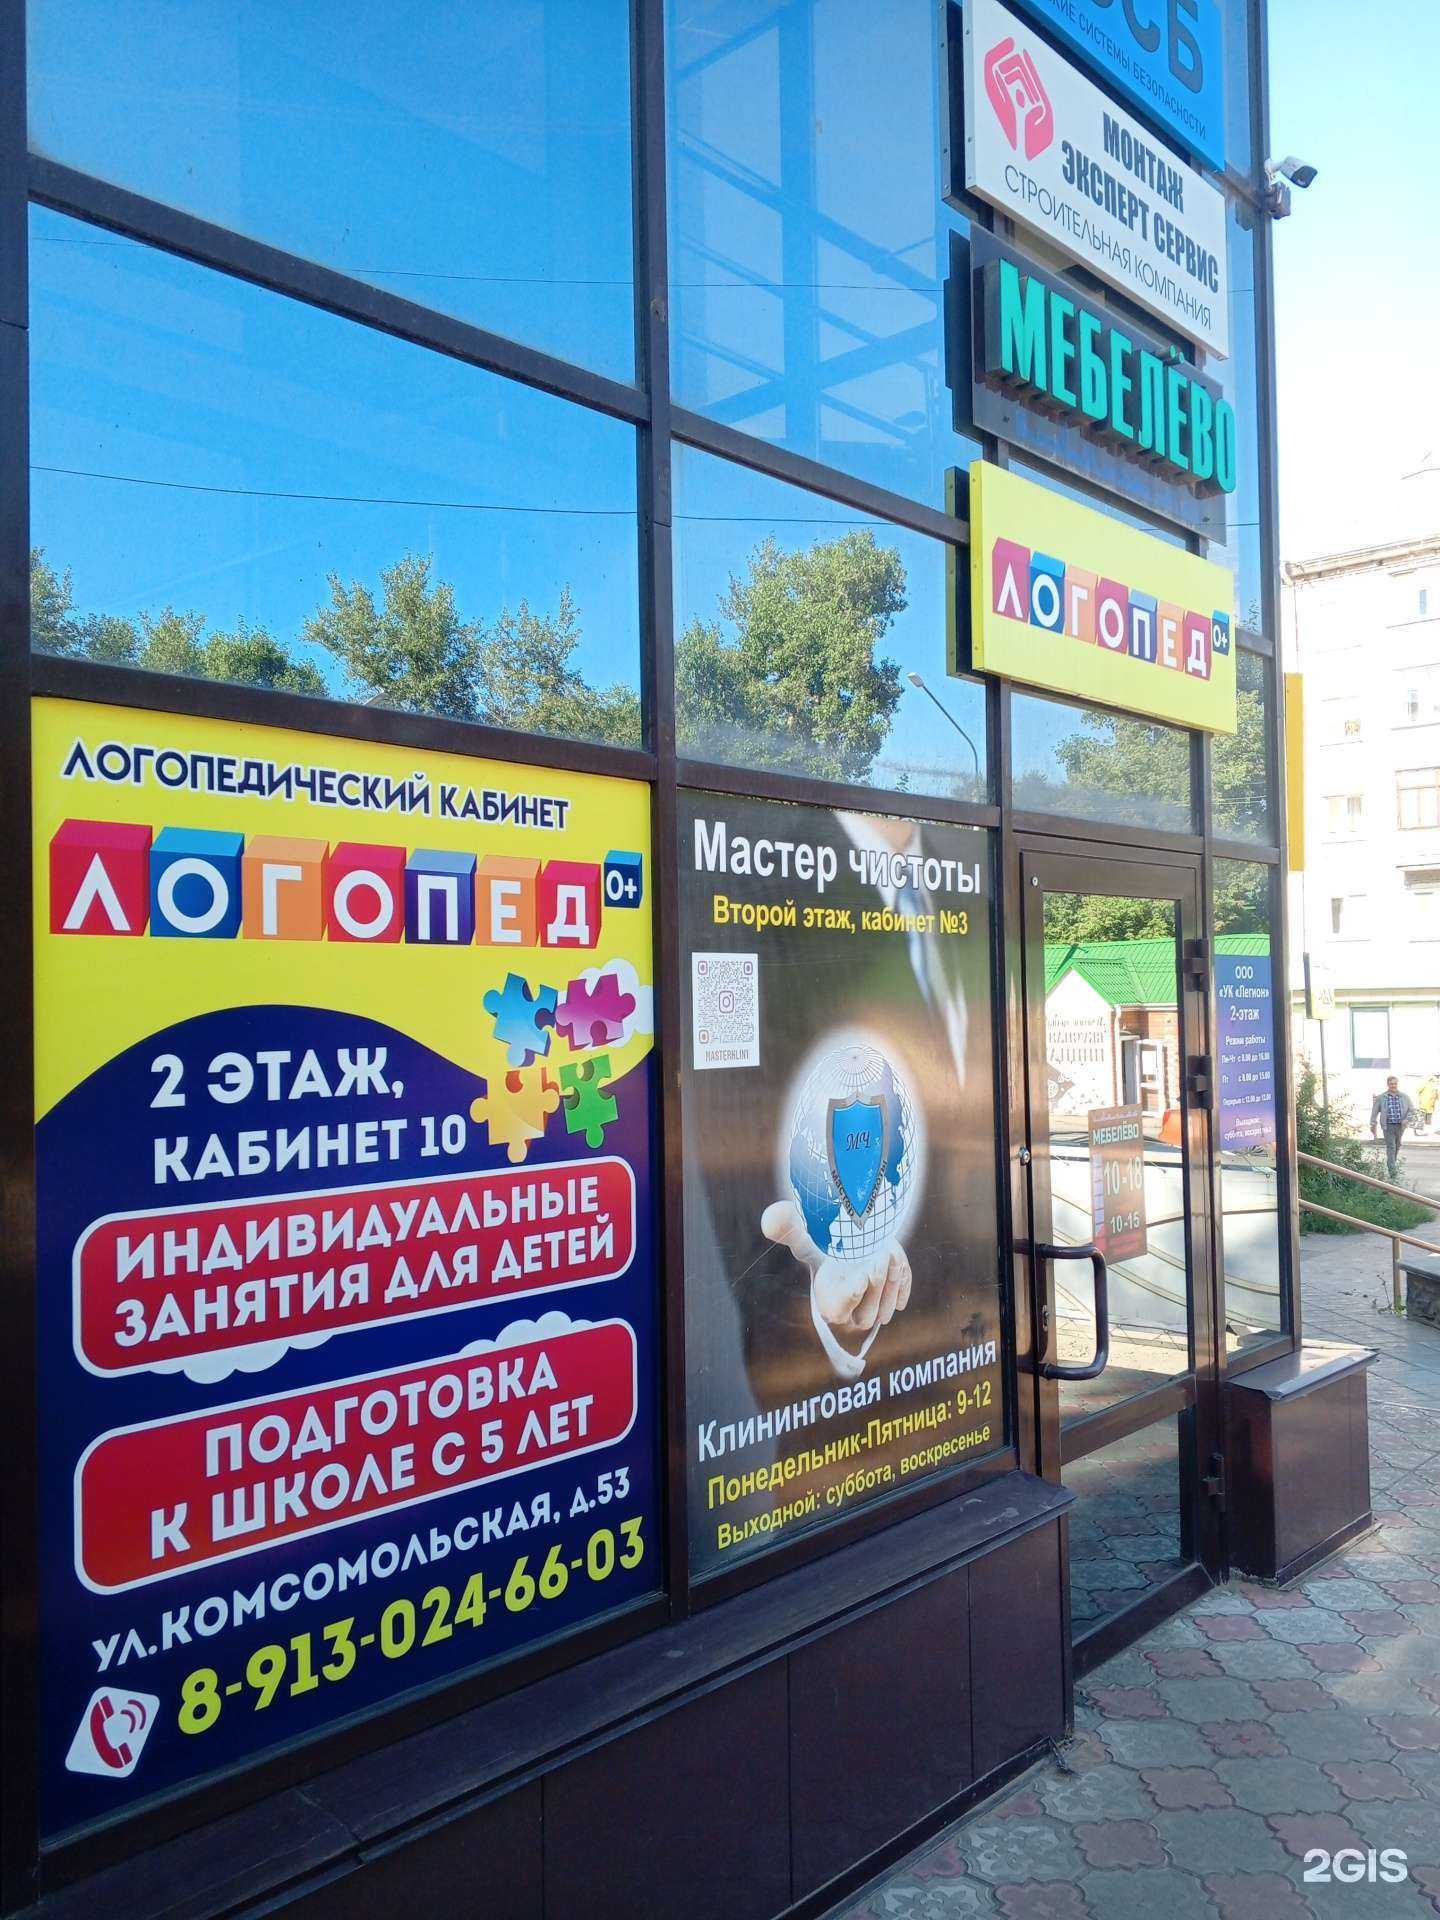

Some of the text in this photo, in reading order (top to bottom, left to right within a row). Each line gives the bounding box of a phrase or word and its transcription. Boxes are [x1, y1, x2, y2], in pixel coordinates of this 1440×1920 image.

[1079, 12, 1130, 75] СИСТЕМЫ
[1133, 60, 1206, 139] БЕЗОПАСНОСТИ
[1095, 0, 1204, 94] СБ
[1061, 139, 1219, 293] ЭКСПЕРТ СЕРВИС
[1103, 111, 1184, 214] МОНТАЖ
[1004, 164, 1212, 331] СТРОИТЕЛЬНАЯ КОМПАНИЯ
[1000, 257, 1236, 494] МЕБЕЛЁВО
[997, 561, 1228, 677] ЛОГОПЕД 0+
[63, 737, 569, 830] ЛОГОПЕДИЧЕСКИЙ КАБИНЕТ
[62, 851, 638, 945] ЛОГОПЕД 0+
[694, 818, 981, 895] Мастер чистоты
[712, 894, 969, 935] Второй этаж, кабинет №3
[1230, 1005, 1260, 1021] 2-этаж
[1235, 965, 1254, 980] ООО
[150, 1046, 405, 1109] 2 ЭТАЖ,
[153, 1114, 467, 1186] КАБИНЕТ 10
[1093, 1120, 1139, 1146] МЕБЕЛЁВО
[115, 1175, 600, 1284] ИНДИВИДУАЛЬНЫЕ
[1110, 1211, 1140, 1234] 10-15
[114, 1212, 616, 1348] ЗАНЯТИЯ ДЛЯ ДЕТЕЙ
[205, 1350, 559, 1479] ПОДГОТОВКА
[698, 1340, 997, 1462] Клининговая компания
[708, 1380, 992, 1509] Понедельник-Пятница: 9-12
[150, 1394, 595, 1560] К ШКОЛЕ С 5 ЛЕТ
[717, 1424, 991, 1550] Выходной: суббота, воскресенье
[177, 1515, 645, 1735] 8-913-024-66-03
